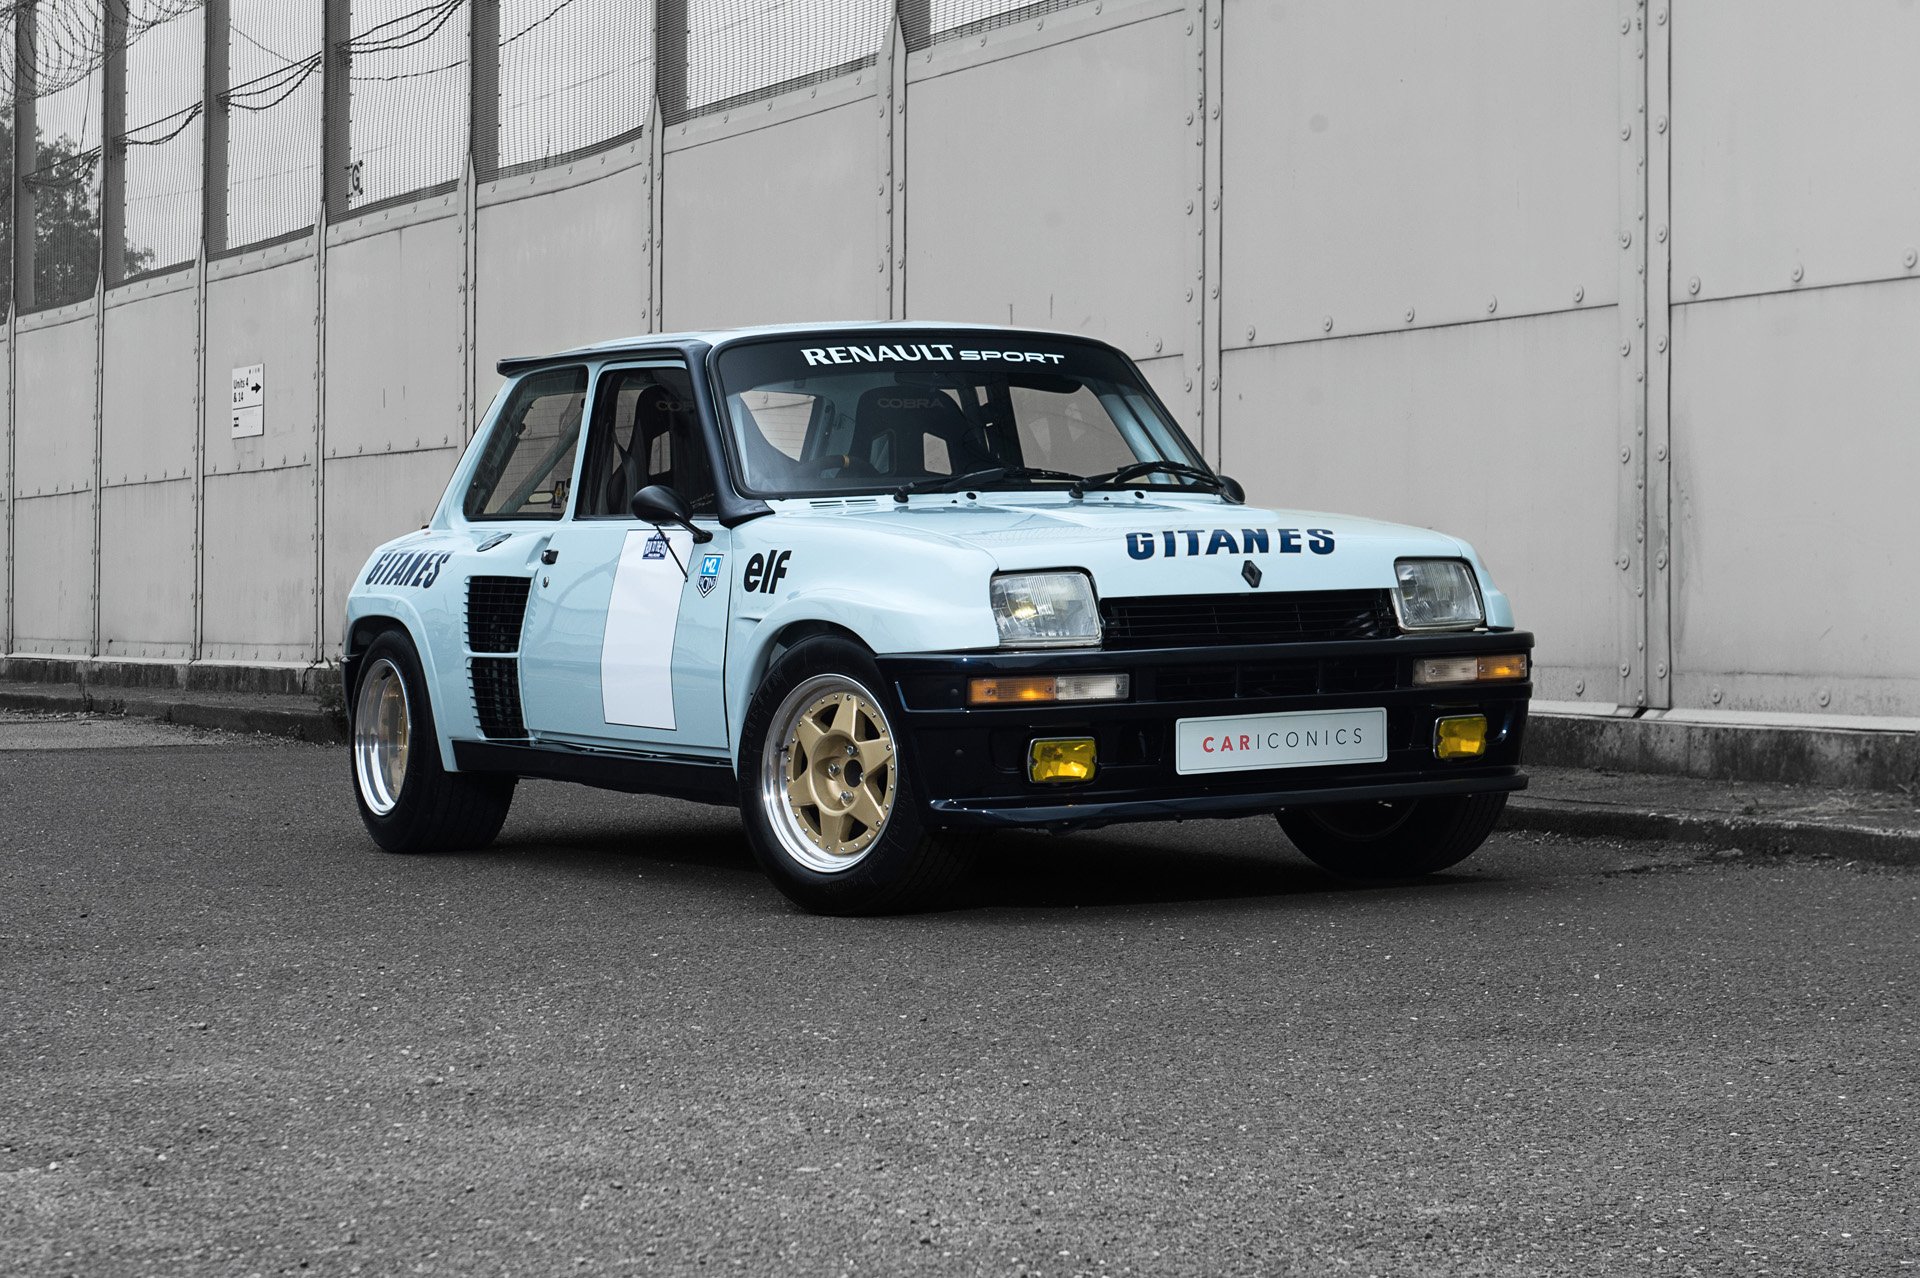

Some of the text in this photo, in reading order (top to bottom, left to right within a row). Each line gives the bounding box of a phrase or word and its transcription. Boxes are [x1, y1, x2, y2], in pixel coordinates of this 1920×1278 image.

[801, 344, 1064, 366] RENAULT SPORT
[233, 378, 245, 389] Units
[238, 391, 244, 401] 14
[878, 398, 945, 409] COBRA
[1125, 528, 1335, 560] GITANES
[365, 552, 451, 589] GITANES
[743, 549, 792, 594] elf
